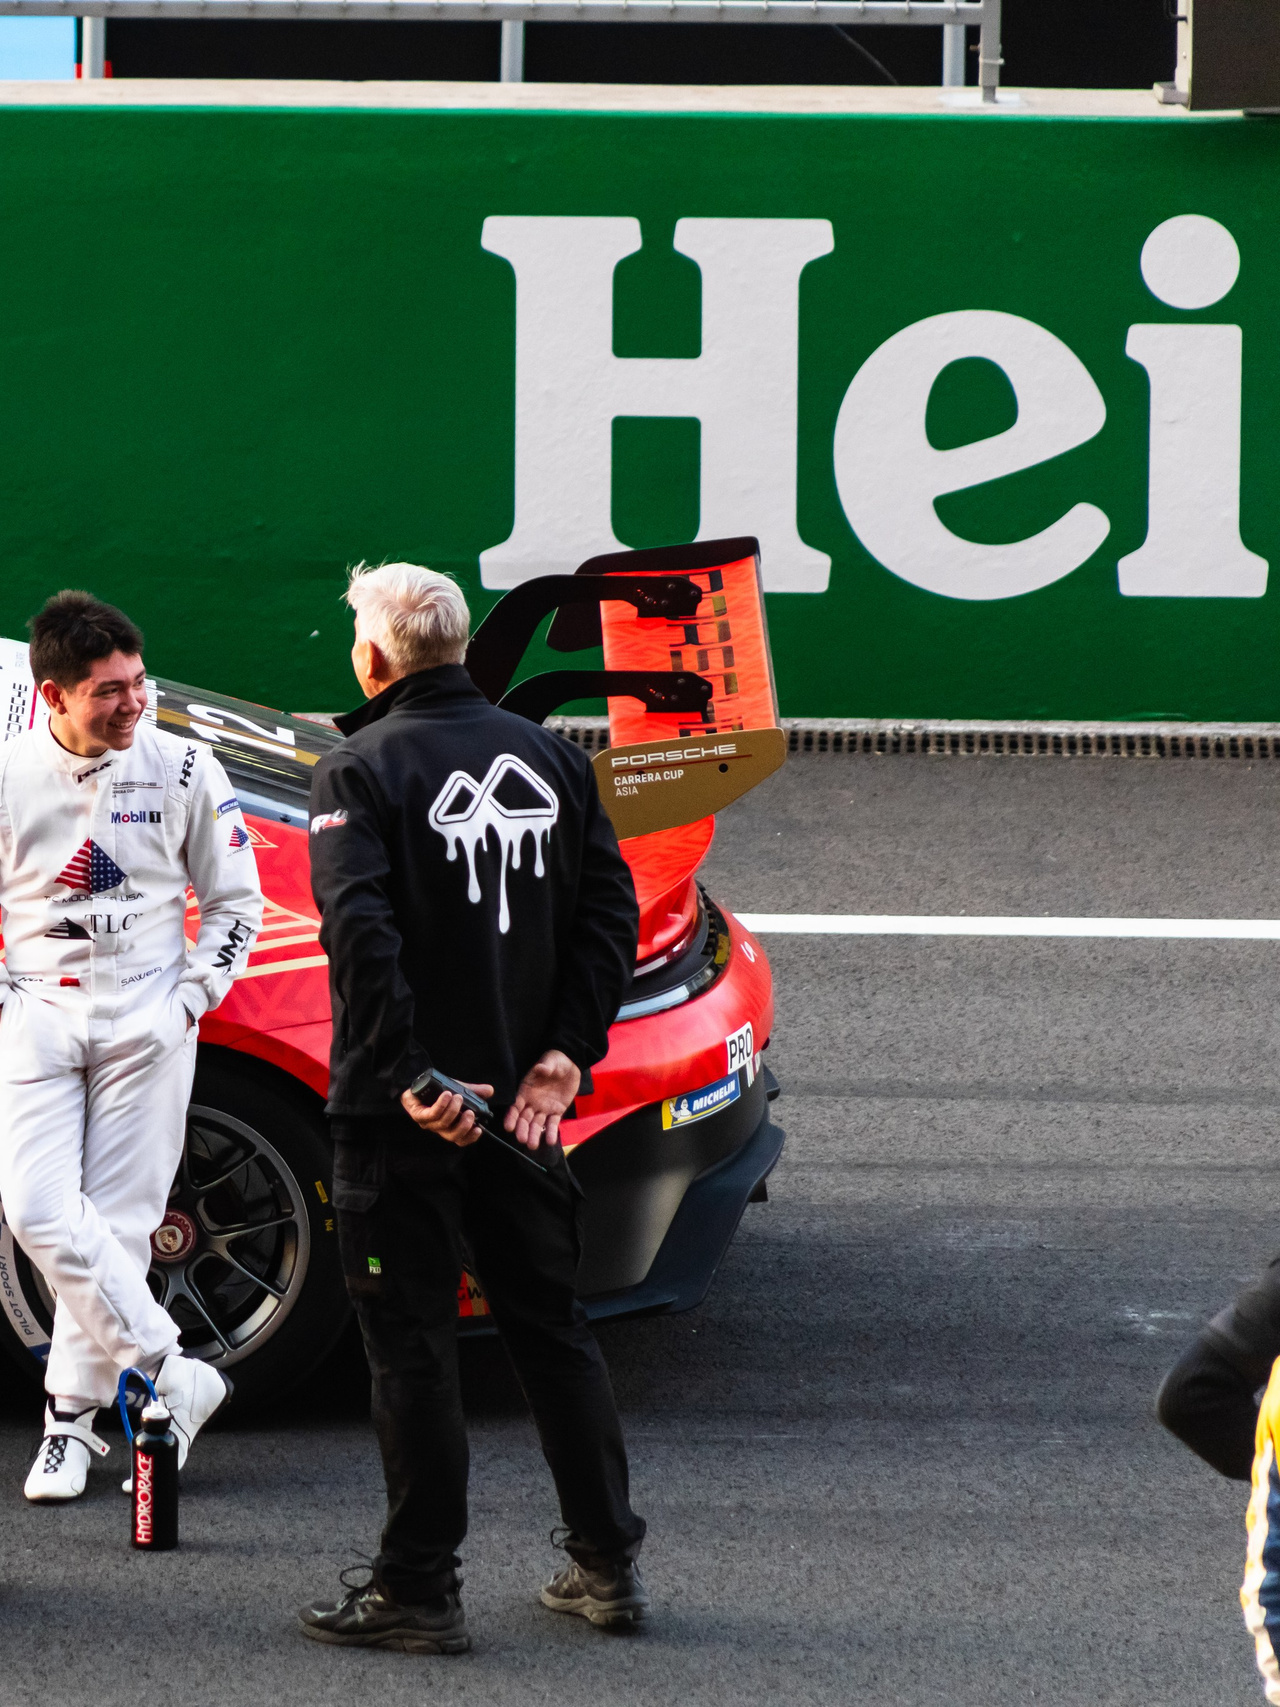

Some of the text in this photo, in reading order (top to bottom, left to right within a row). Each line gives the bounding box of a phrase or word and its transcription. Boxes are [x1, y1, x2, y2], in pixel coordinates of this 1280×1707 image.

[480, 213, 1270, 600] Hei
[187, 704, 296, 757] 12
[611, 743, 737, 767] PORSCHE
[614, 769, 684, 786] CARRERA CUP
[615, 785, 639, 797] ASIA
[111, 811, 147, 824] Mobil
[120, 893, 145, 902] USA
[84, 913, 138, 934] TLC
[121, 967, 163, 987] SAWER
[728, 1027, 753, 1069] PRO
[692, 1079, 736, 1112] MICHELIN
[8, 1301, 35, 1336] PILOT
[136, 1453, 153, 1543] HYDRORACE
